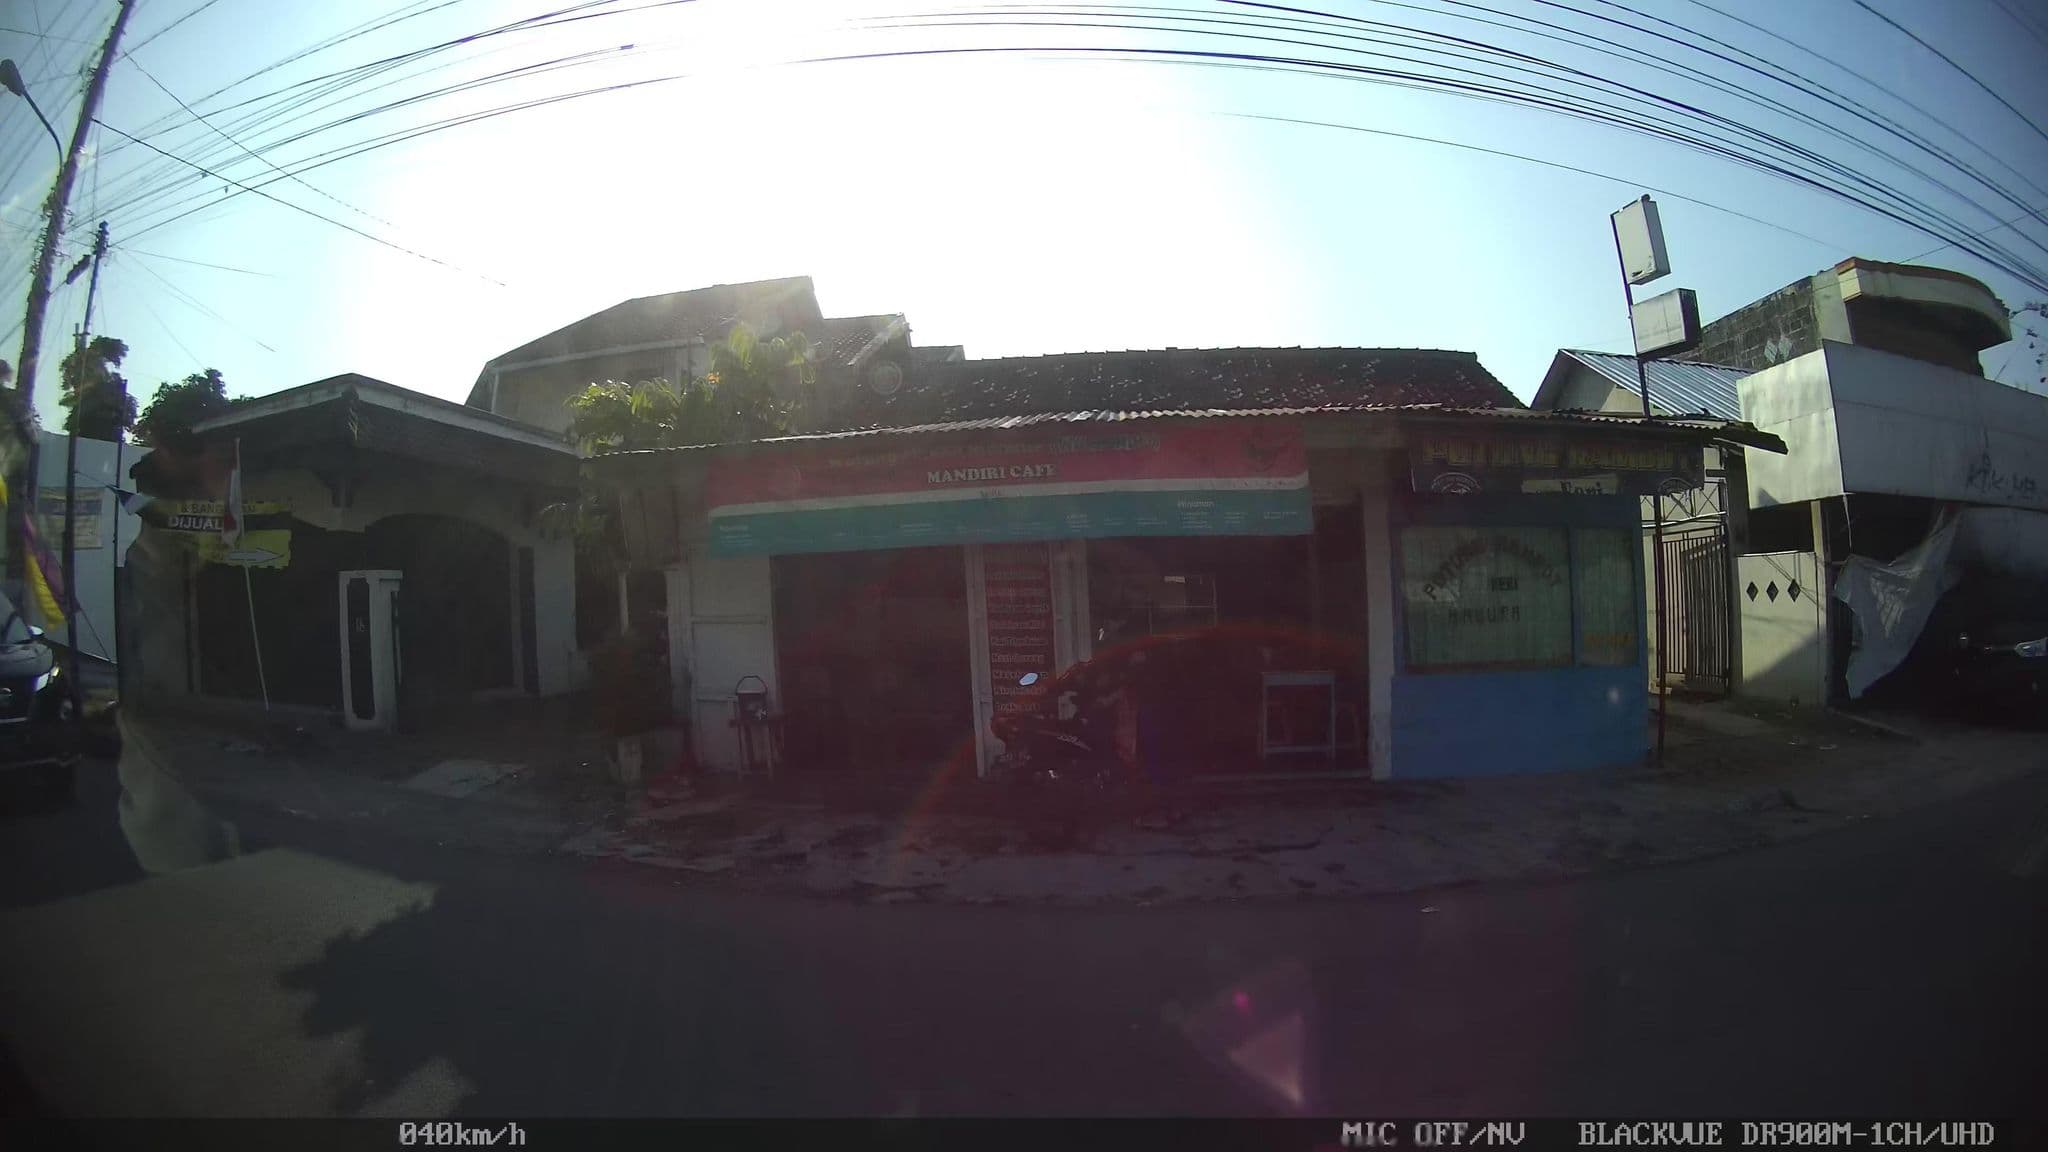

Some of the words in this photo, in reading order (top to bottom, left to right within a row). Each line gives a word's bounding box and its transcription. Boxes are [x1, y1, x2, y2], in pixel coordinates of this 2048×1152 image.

[927, 466, 1006, 484] MANDIRI
[1009, 464, 1055, 478] CAFE
[167, 515, 224, 530] DIJUAL
